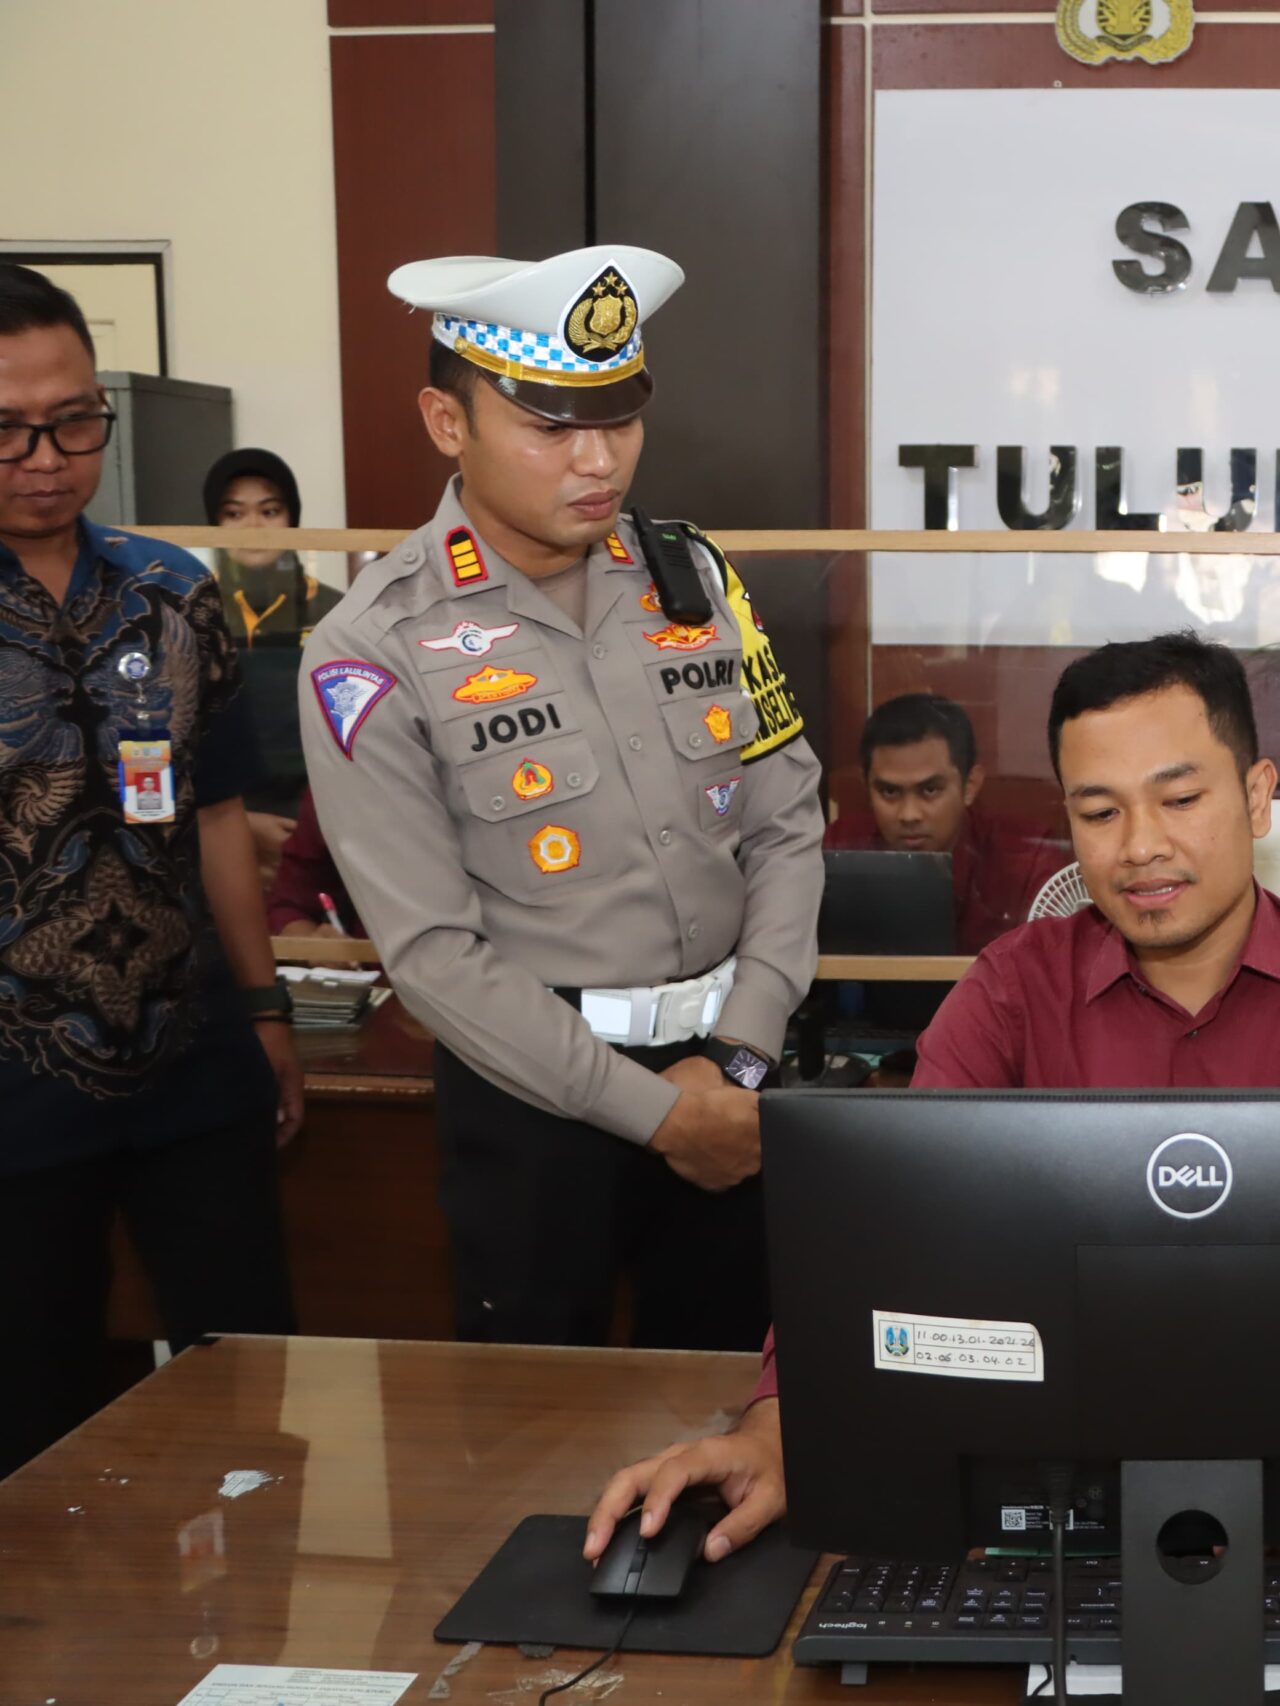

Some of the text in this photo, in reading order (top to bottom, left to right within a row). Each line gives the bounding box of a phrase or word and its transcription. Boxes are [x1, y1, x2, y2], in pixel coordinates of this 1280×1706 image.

[660, 659, 734, 694] POLRI
[741, 645, 781, 694] KAS
[471, 703, 561, 752] JODI
[1158, 1165, 1223, 1187] DELL
[818, 1621, 867, 1631] logitech
